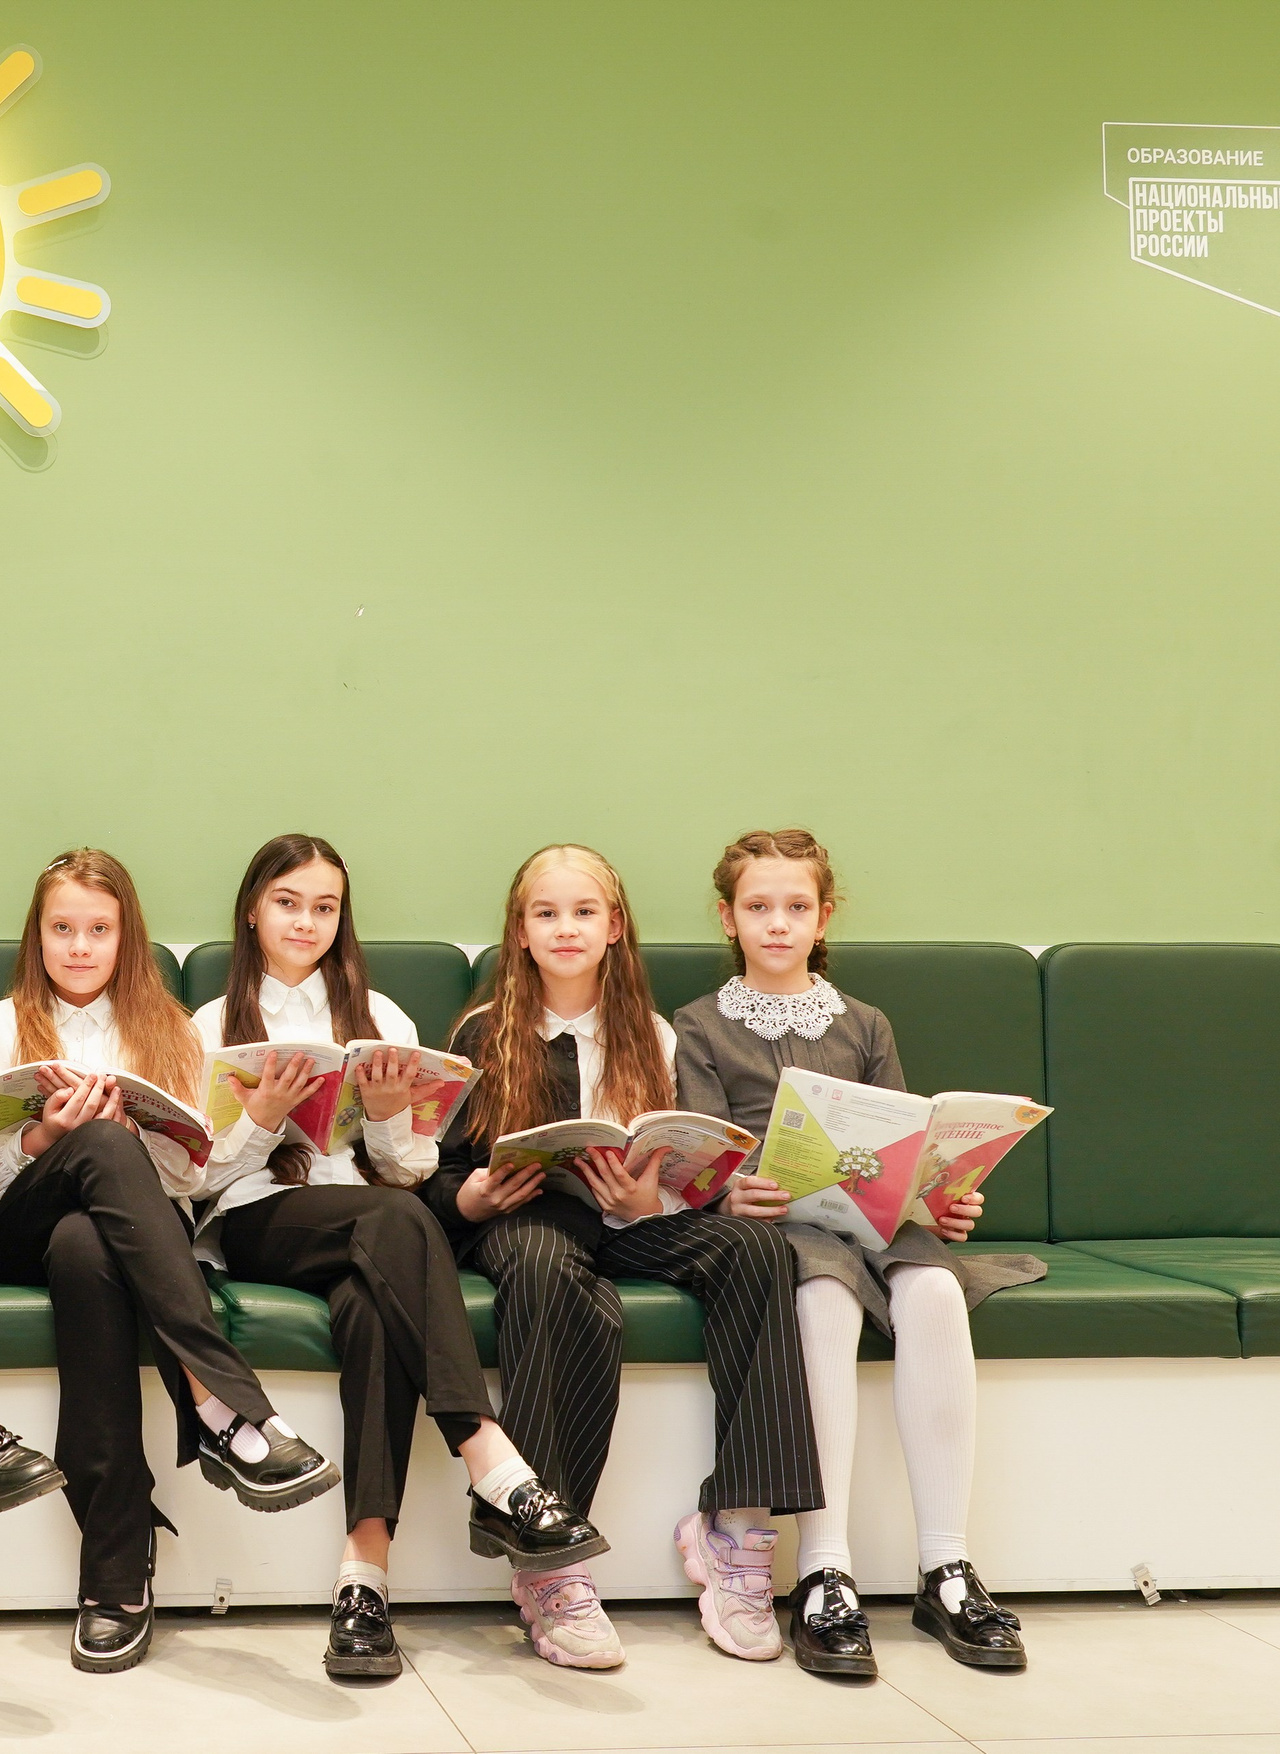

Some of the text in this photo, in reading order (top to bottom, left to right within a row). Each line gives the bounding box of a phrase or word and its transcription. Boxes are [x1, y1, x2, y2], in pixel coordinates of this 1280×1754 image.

[1127, 148, 1264, 166] ОБРАЗОВАНИЕ
[1135, 184, 1280, 209] НАЦИОНАЛЬНЫ
[1136, 209, 1224, 233] ПРОЕКТЫ
[1137, 234, 1209, 258] РОССИИ
[943, 1165, 985, 1200] 4
